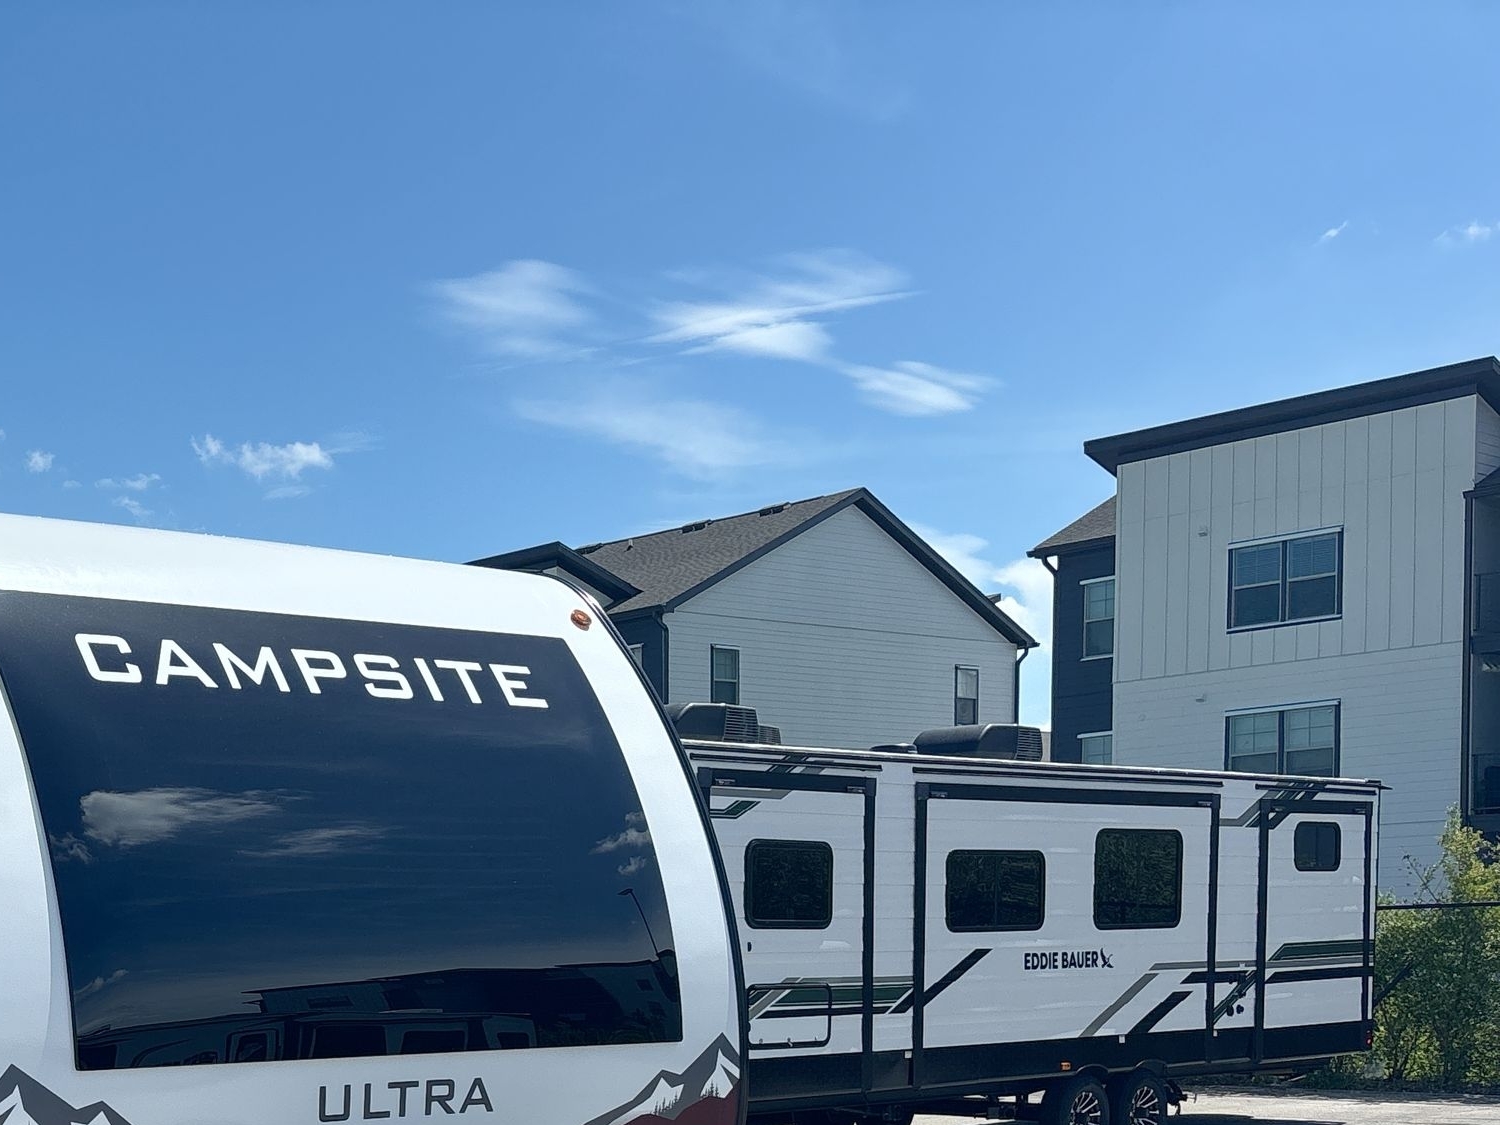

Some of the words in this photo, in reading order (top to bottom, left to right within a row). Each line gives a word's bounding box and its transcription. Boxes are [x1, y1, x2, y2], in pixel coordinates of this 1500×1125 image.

[74, 632, 548, 710] CAMPSITE
[1024, 952, 1058, 970] EDDIE
[1062, 951, 1098, 969] BAUER
[318, 1076, 494, 1123] ULTRA
